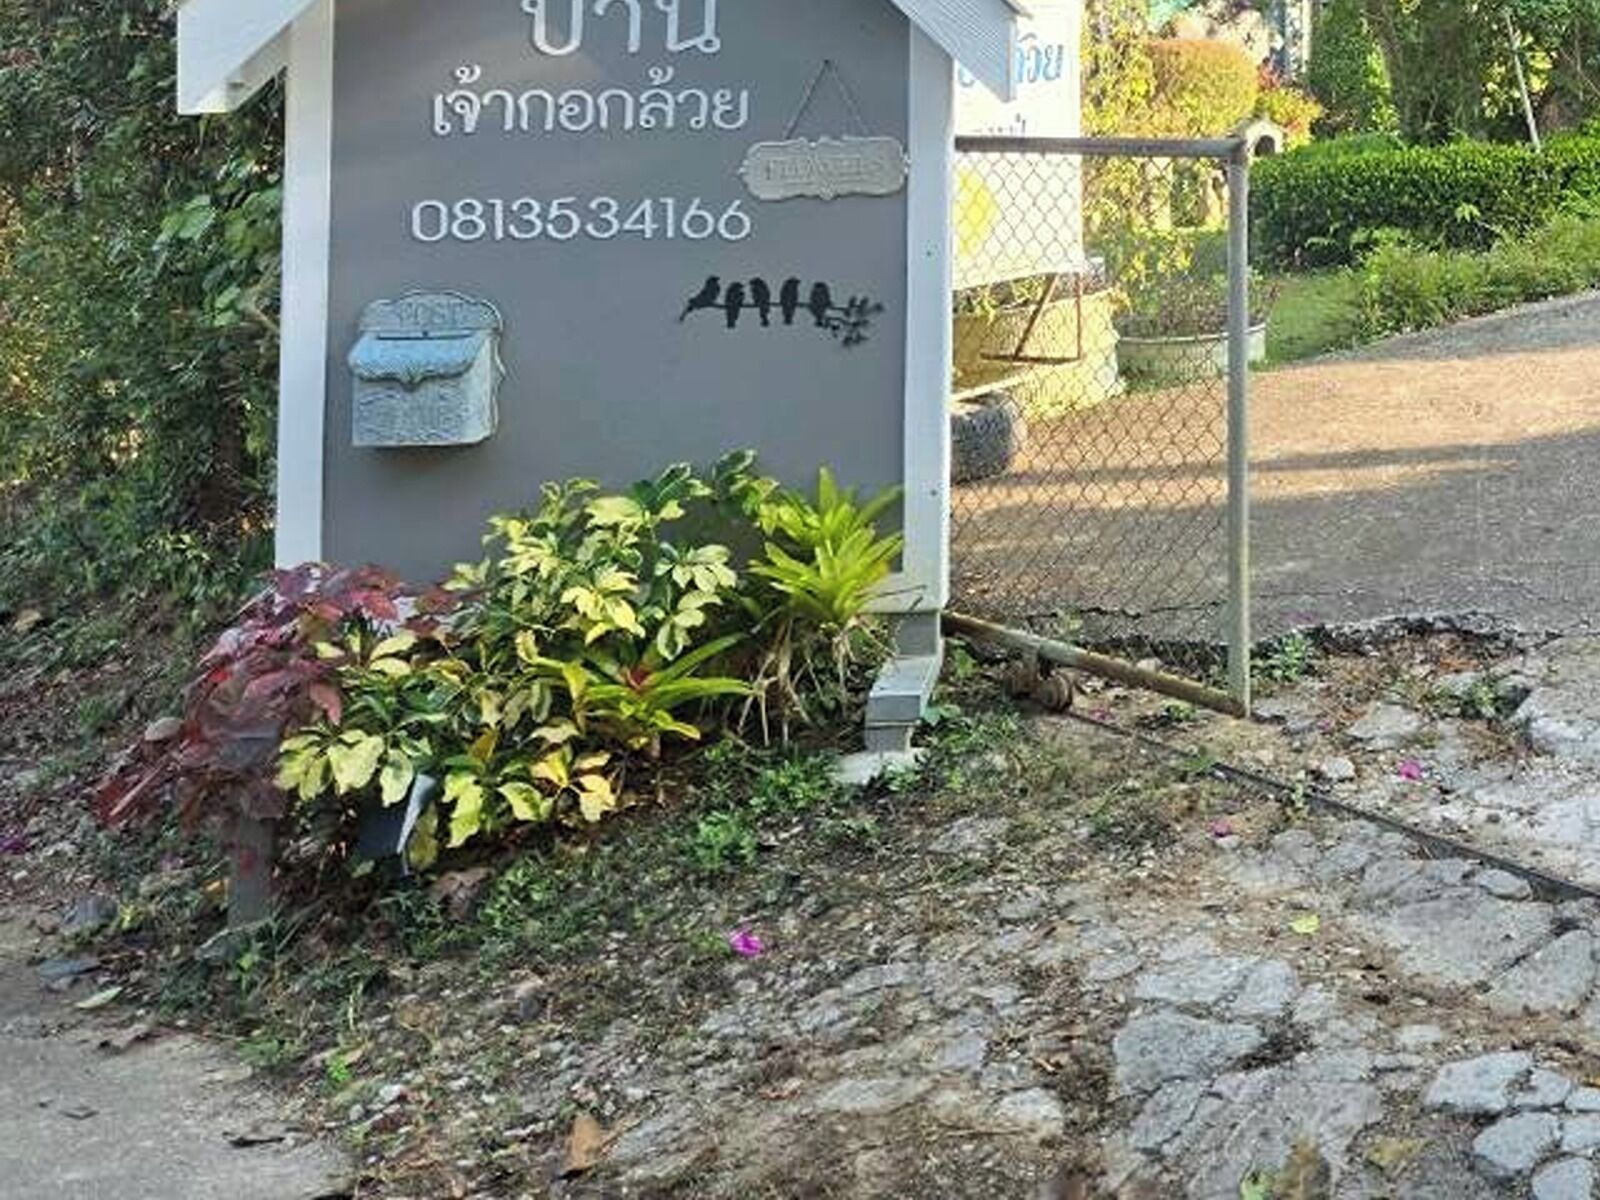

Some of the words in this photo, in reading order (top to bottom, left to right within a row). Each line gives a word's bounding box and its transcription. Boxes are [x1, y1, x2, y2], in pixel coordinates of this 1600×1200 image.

[433, 64, 750, 136] เจ้ากอกล้วย
[411, 197, 752, 241] 0813534166
